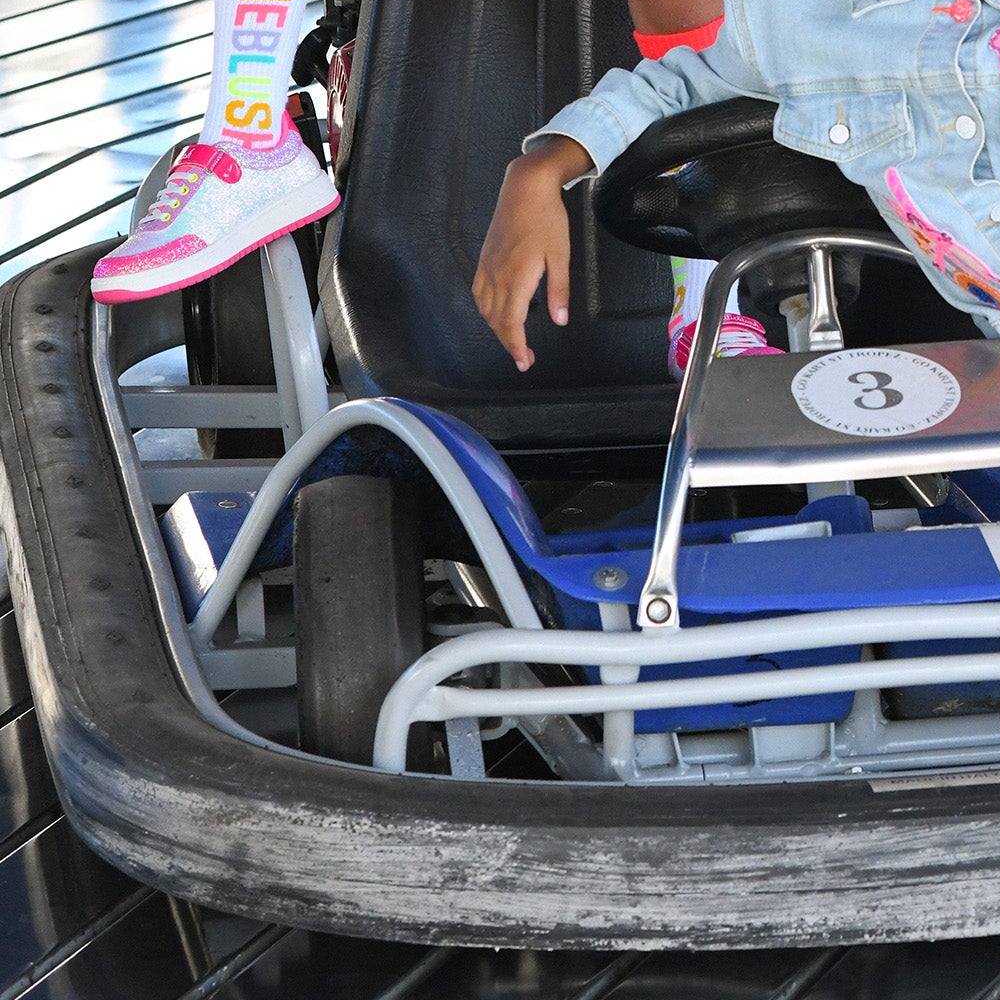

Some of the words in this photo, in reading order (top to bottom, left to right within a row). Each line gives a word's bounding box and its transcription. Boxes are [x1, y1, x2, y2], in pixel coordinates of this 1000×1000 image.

[806, 362, 827, 379] KART
[849, 351, 901, 359] TROPEZ
[912, 358, 930, 367] GO
[848, 371, 903, 410] 3
